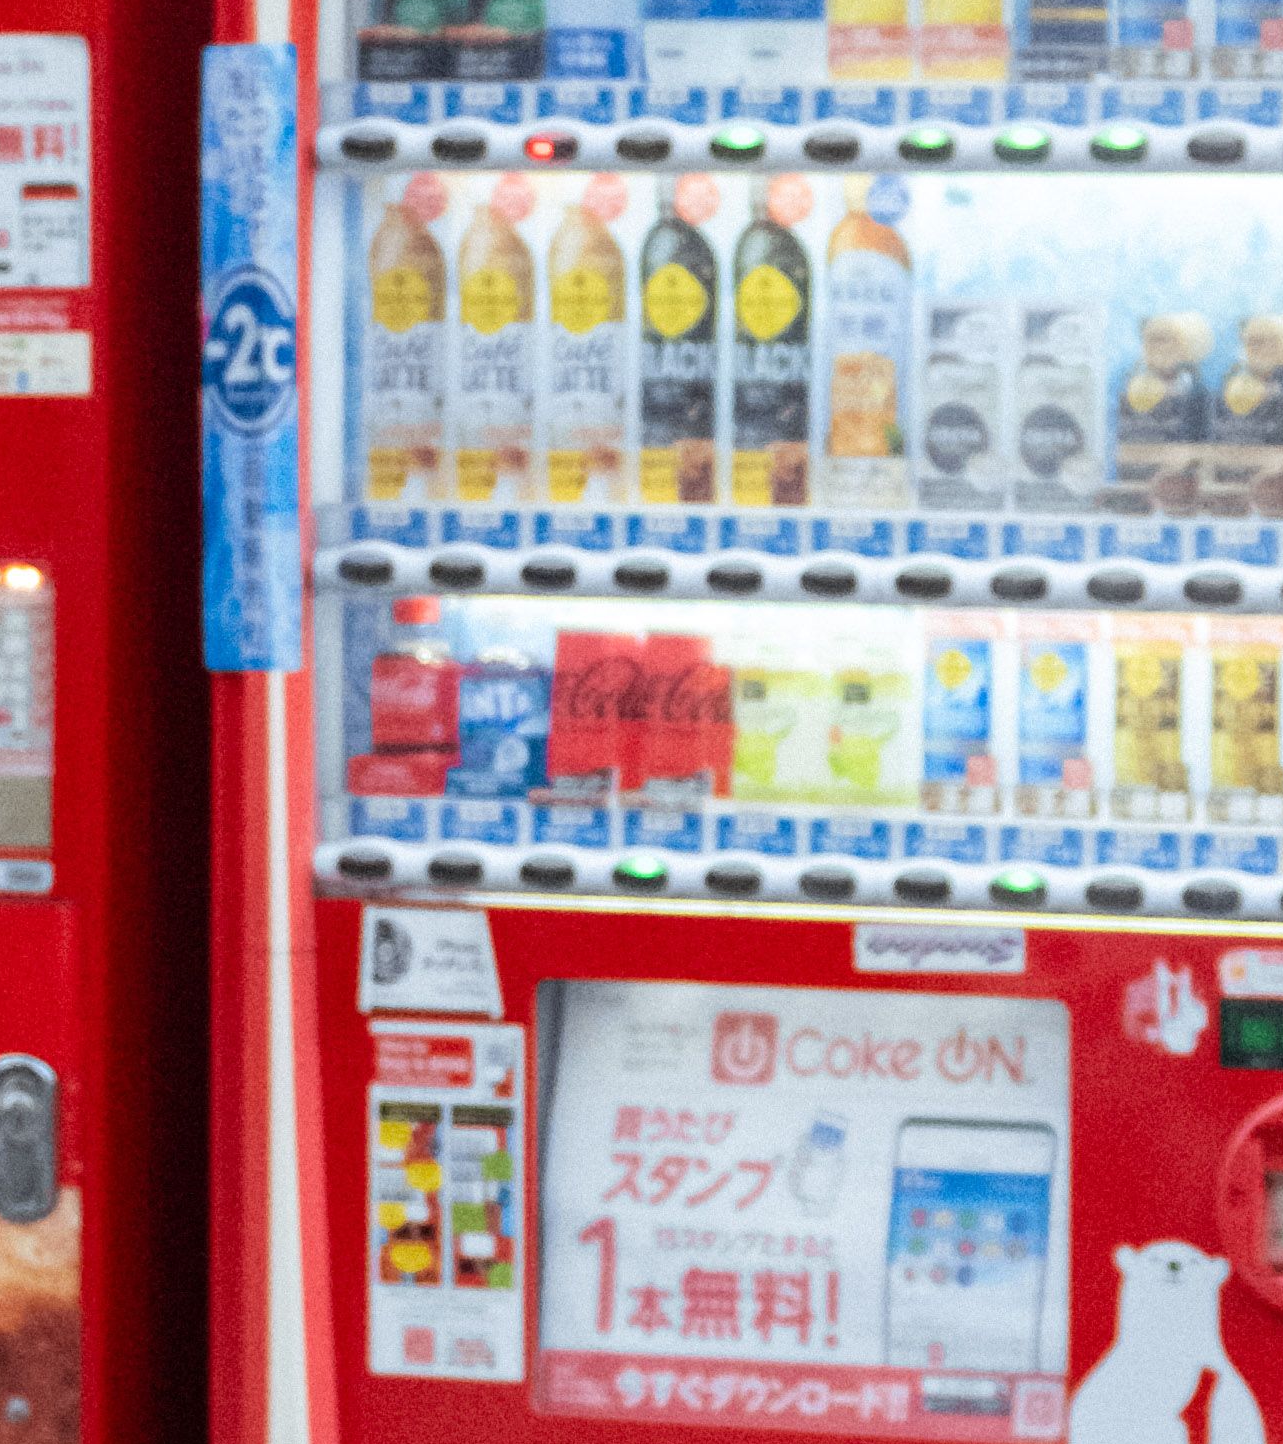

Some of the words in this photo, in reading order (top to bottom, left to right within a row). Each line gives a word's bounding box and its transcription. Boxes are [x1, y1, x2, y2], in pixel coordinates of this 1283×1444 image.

[787, 1027, 923, 1080] Coke
[937, 1029, 1031, 1084] ON
[613, 1106, 735, 1146] 買うたび
[601, 1150, 784, 1211] スタンプ
[578, 1218, 840, 1348] 1本無料!
